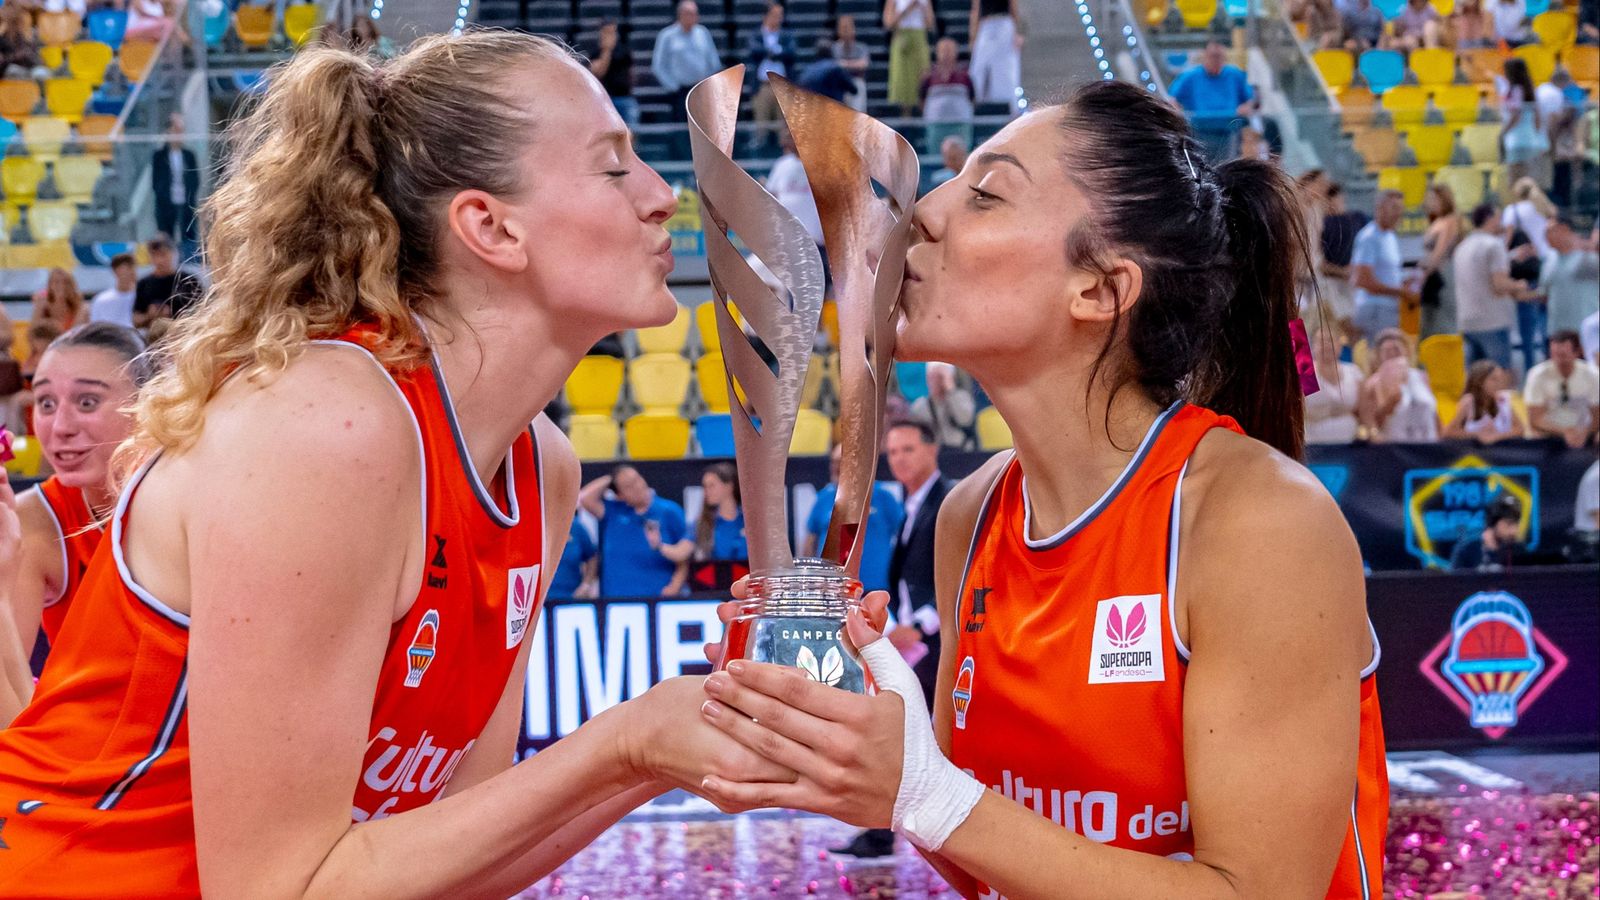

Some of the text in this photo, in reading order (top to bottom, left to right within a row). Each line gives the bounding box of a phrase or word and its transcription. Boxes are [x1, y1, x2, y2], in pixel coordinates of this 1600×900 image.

[782, 629, 843, 640] CAMPEÓ
[1100, 651, 1152, 668] SUPERCOPA
[1128, 801, 1190, 840] del
